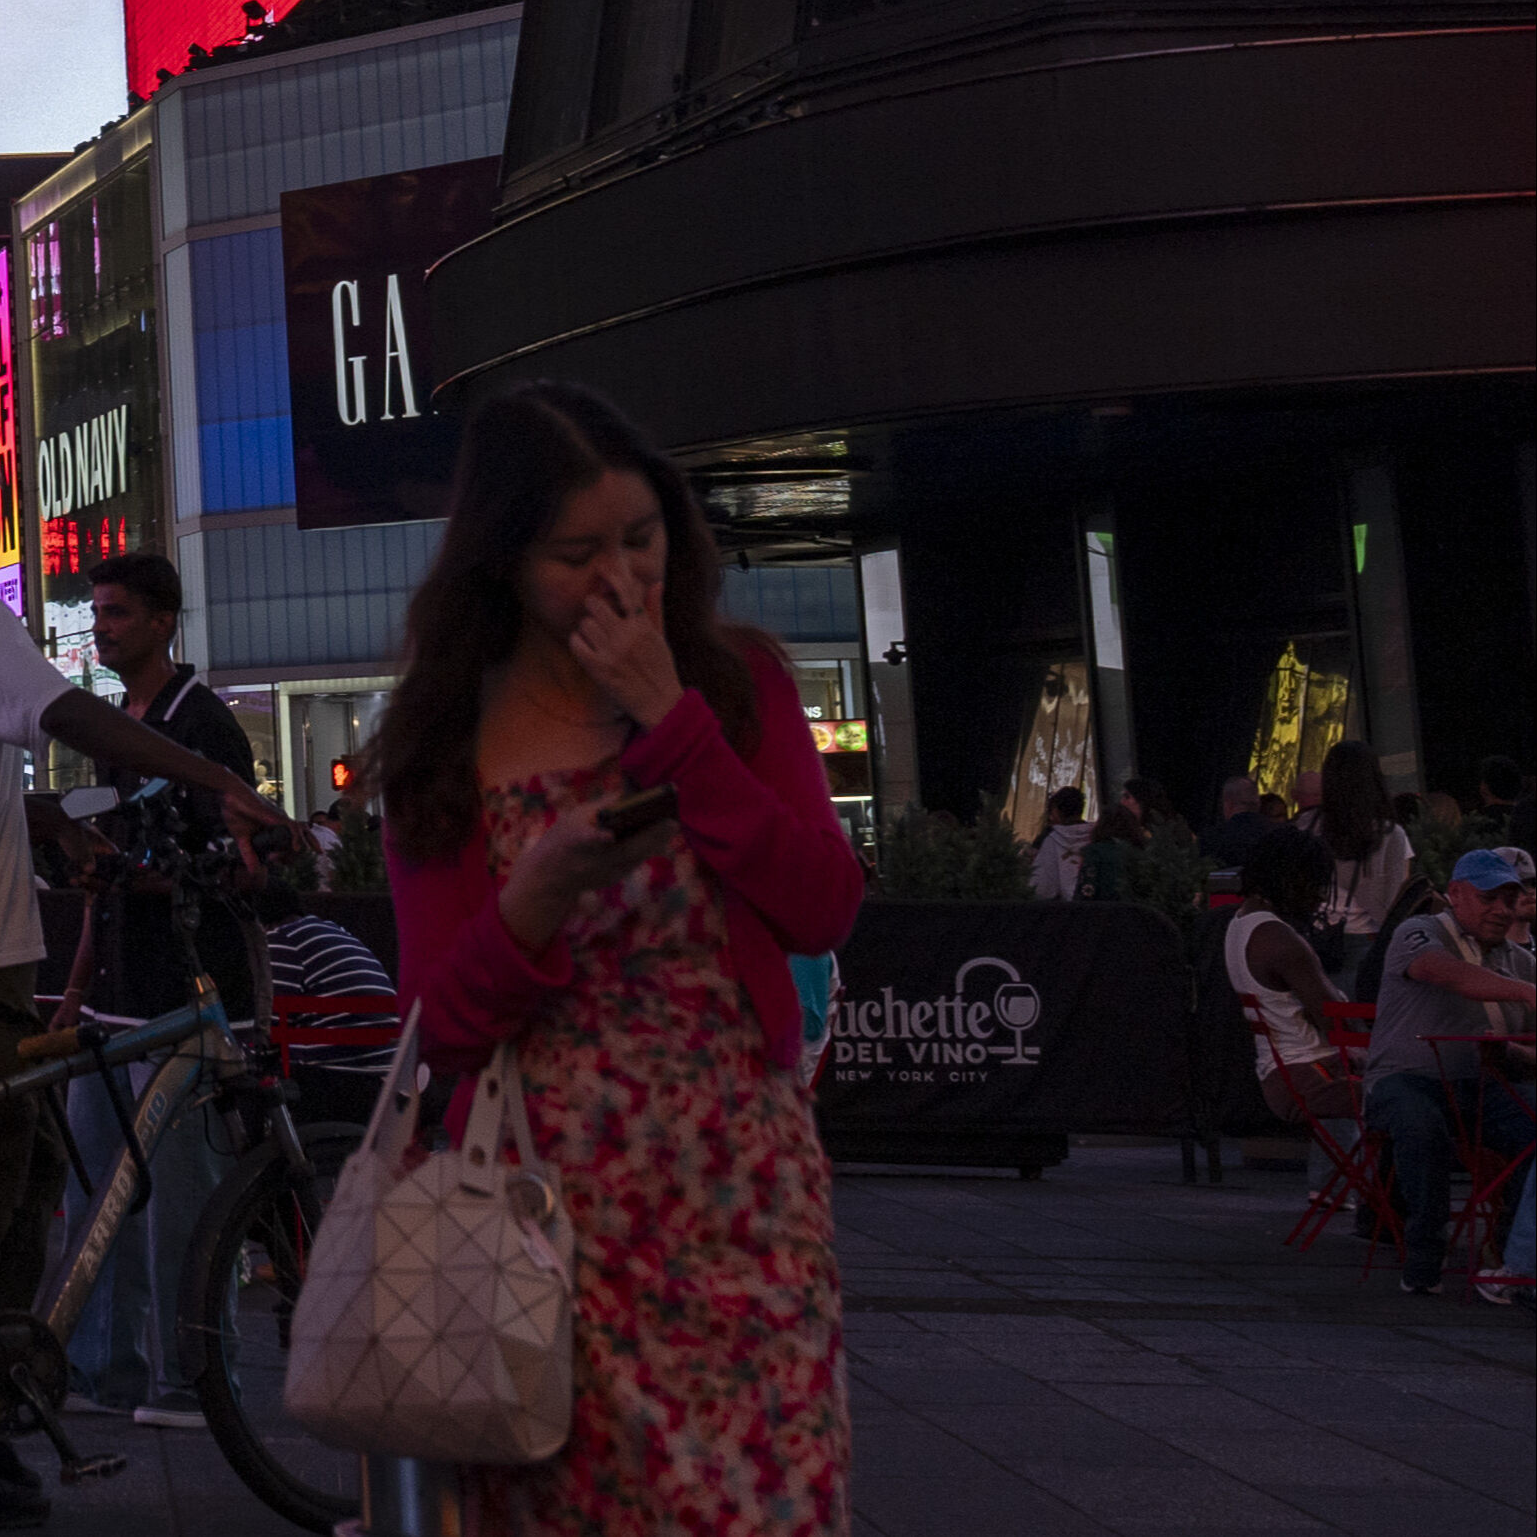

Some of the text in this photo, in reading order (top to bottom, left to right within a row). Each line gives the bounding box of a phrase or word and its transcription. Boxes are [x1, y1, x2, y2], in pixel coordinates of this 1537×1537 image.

[332, 274, 422, 426] GA
[38, 431, 74, 521] OLD
[76, 404, 126, 509] NAVY
[833, 986, 996, 1040] uchette
[835, 1042, 988, 1064] DEL VINO
[835, 1071, 988, 1083] NEW YORK CITY
